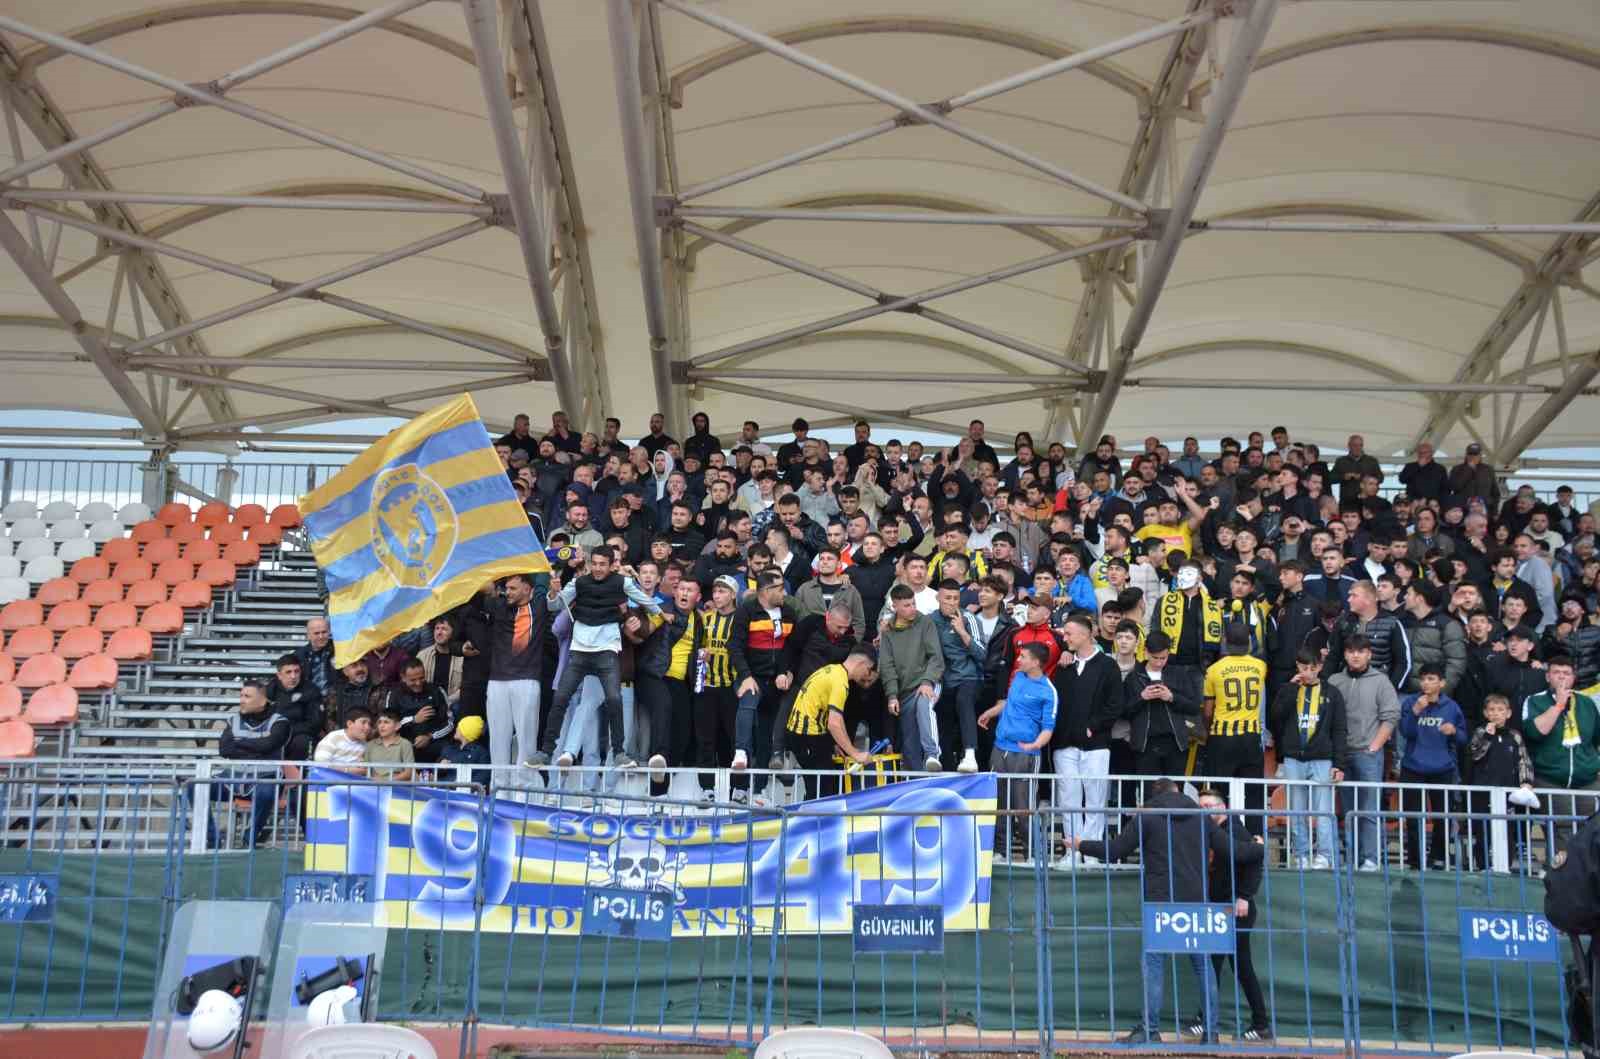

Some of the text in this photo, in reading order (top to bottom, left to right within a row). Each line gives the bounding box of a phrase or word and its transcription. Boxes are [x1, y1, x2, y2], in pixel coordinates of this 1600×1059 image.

[1224, 677, 1259, 711] 96
[751, 786, 979, 926] 49
[861, 915, 935, 936] GÜVENLİK
[1155, 907, 1228, 934] POLİS
[1472, 914, 1549, 942] POLİS
